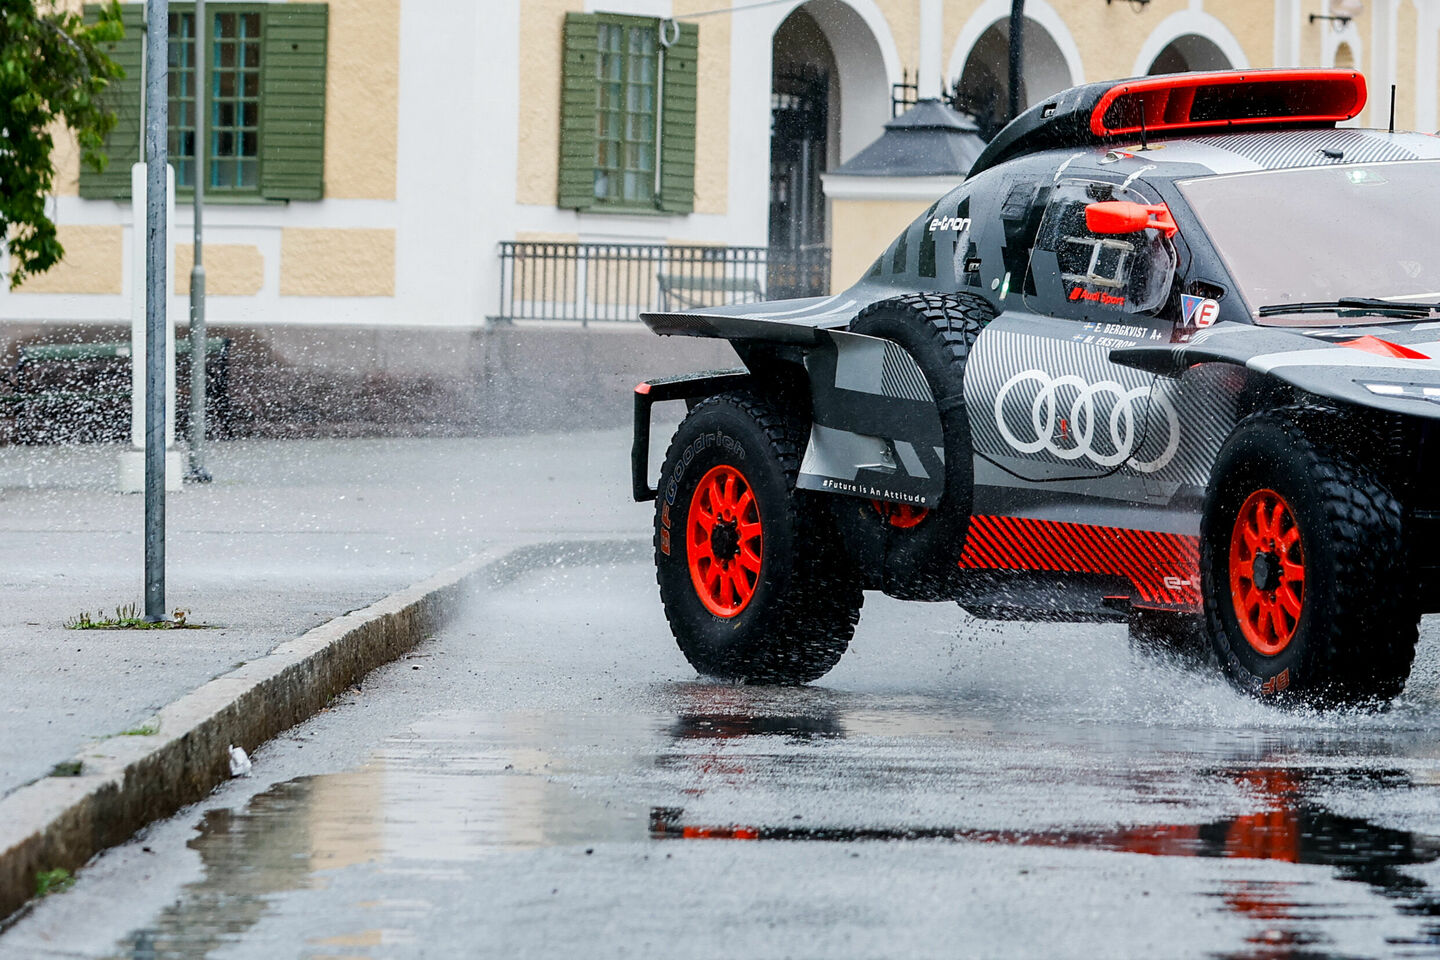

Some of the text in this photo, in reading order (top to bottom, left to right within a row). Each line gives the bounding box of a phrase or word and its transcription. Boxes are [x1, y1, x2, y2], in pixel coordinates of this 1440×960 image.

[929, 215, 972, 231] e-tron
[1080, 290, 1126, 306] Audi Sport
[1199, 304, 1215, 325] E
[1094, 322, 1162, 341] E. BERGKVIST A+
[660, 431, 746, 556] BFGoodrich
[822, 479, 857, 492] #Future
[870, 487, 881, 496] An
[884, 489, 926, 503] Attitude
